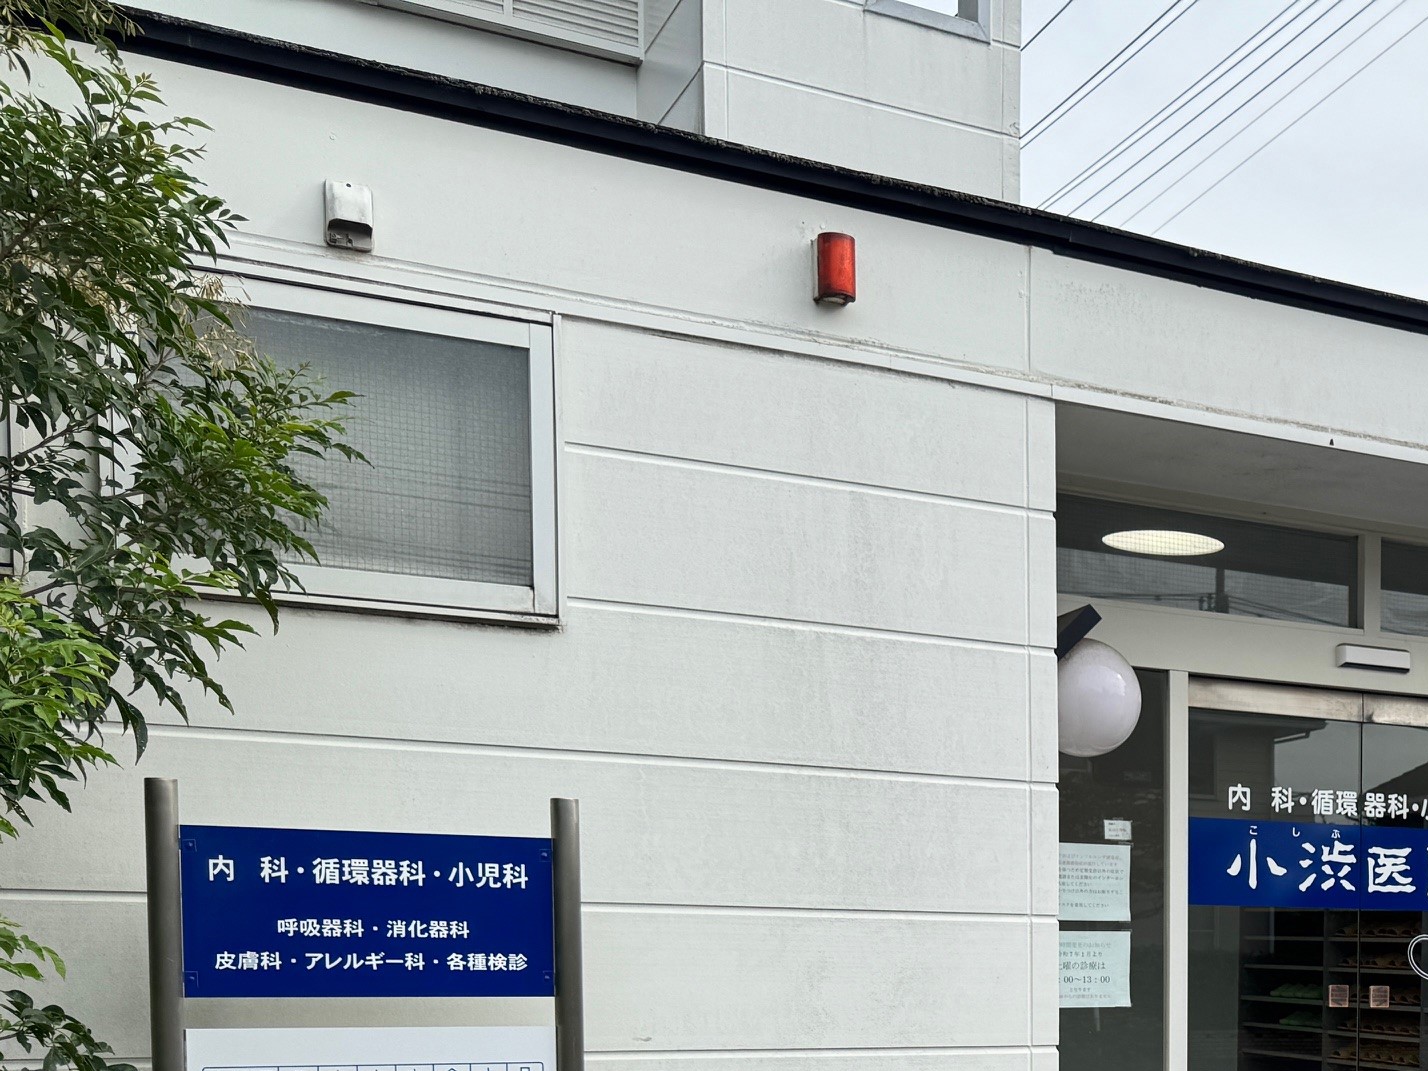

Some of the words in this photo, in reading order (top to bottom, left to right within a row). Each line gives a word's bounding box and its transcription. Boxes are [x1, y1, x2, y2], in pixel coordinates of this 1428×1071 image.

[277, 918, 470, 939] 呼吸器科・消化器科
[214, 950, 528, 971] 皮膚科・アレルギー科・各種検診
